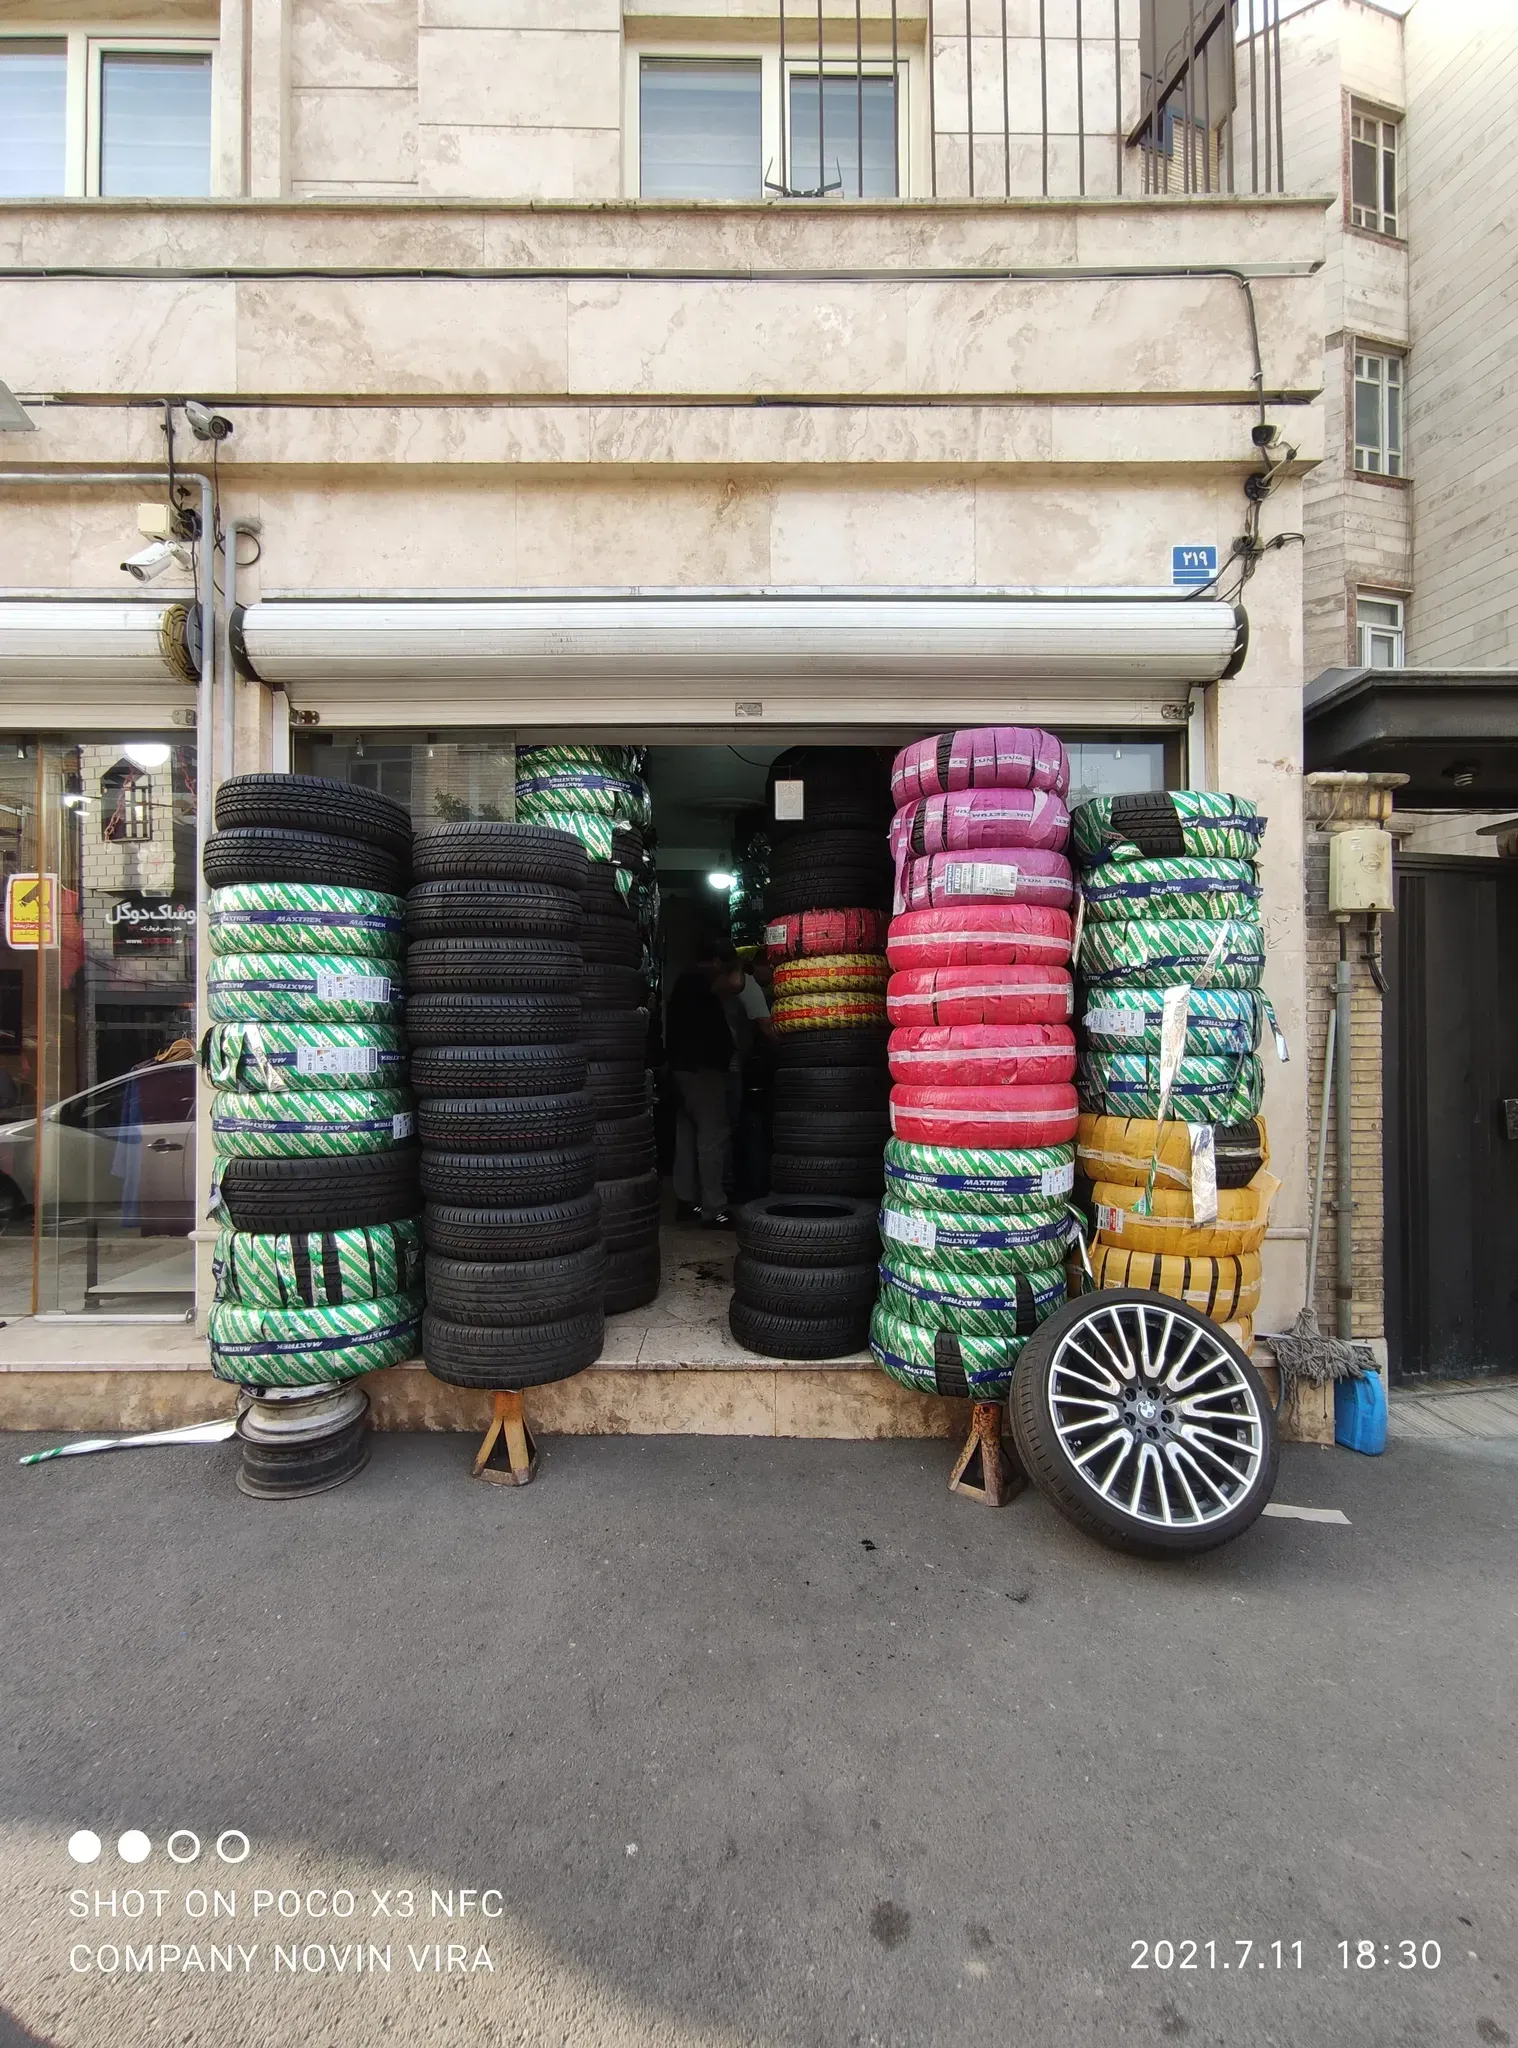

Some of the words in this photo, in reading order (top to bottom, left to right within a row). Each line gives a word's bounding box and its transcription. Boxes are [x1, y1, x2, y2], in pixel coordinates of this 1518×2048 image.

[1182, 551, 1208, 566] ۲۱۹
[106, 902, 150, 924] دوگل
[350, 919, 386, 928] MAXTREK
[268, 982, 314, 990] MAXTREK
[1198, 1018, 1236, 1028] MAXTREK
[904, 1172, 938, 1184] MAXTREK
[936, 1236, 978, 1244] MAXTREK
[892, 1276, 920, 1294] MAXTREK
[940, 1296, 982, 1307] MAXTREK
[276, 1342, 323, 1350] MAXTREK
[351, 1329, 390, 1344] MAXTREK
